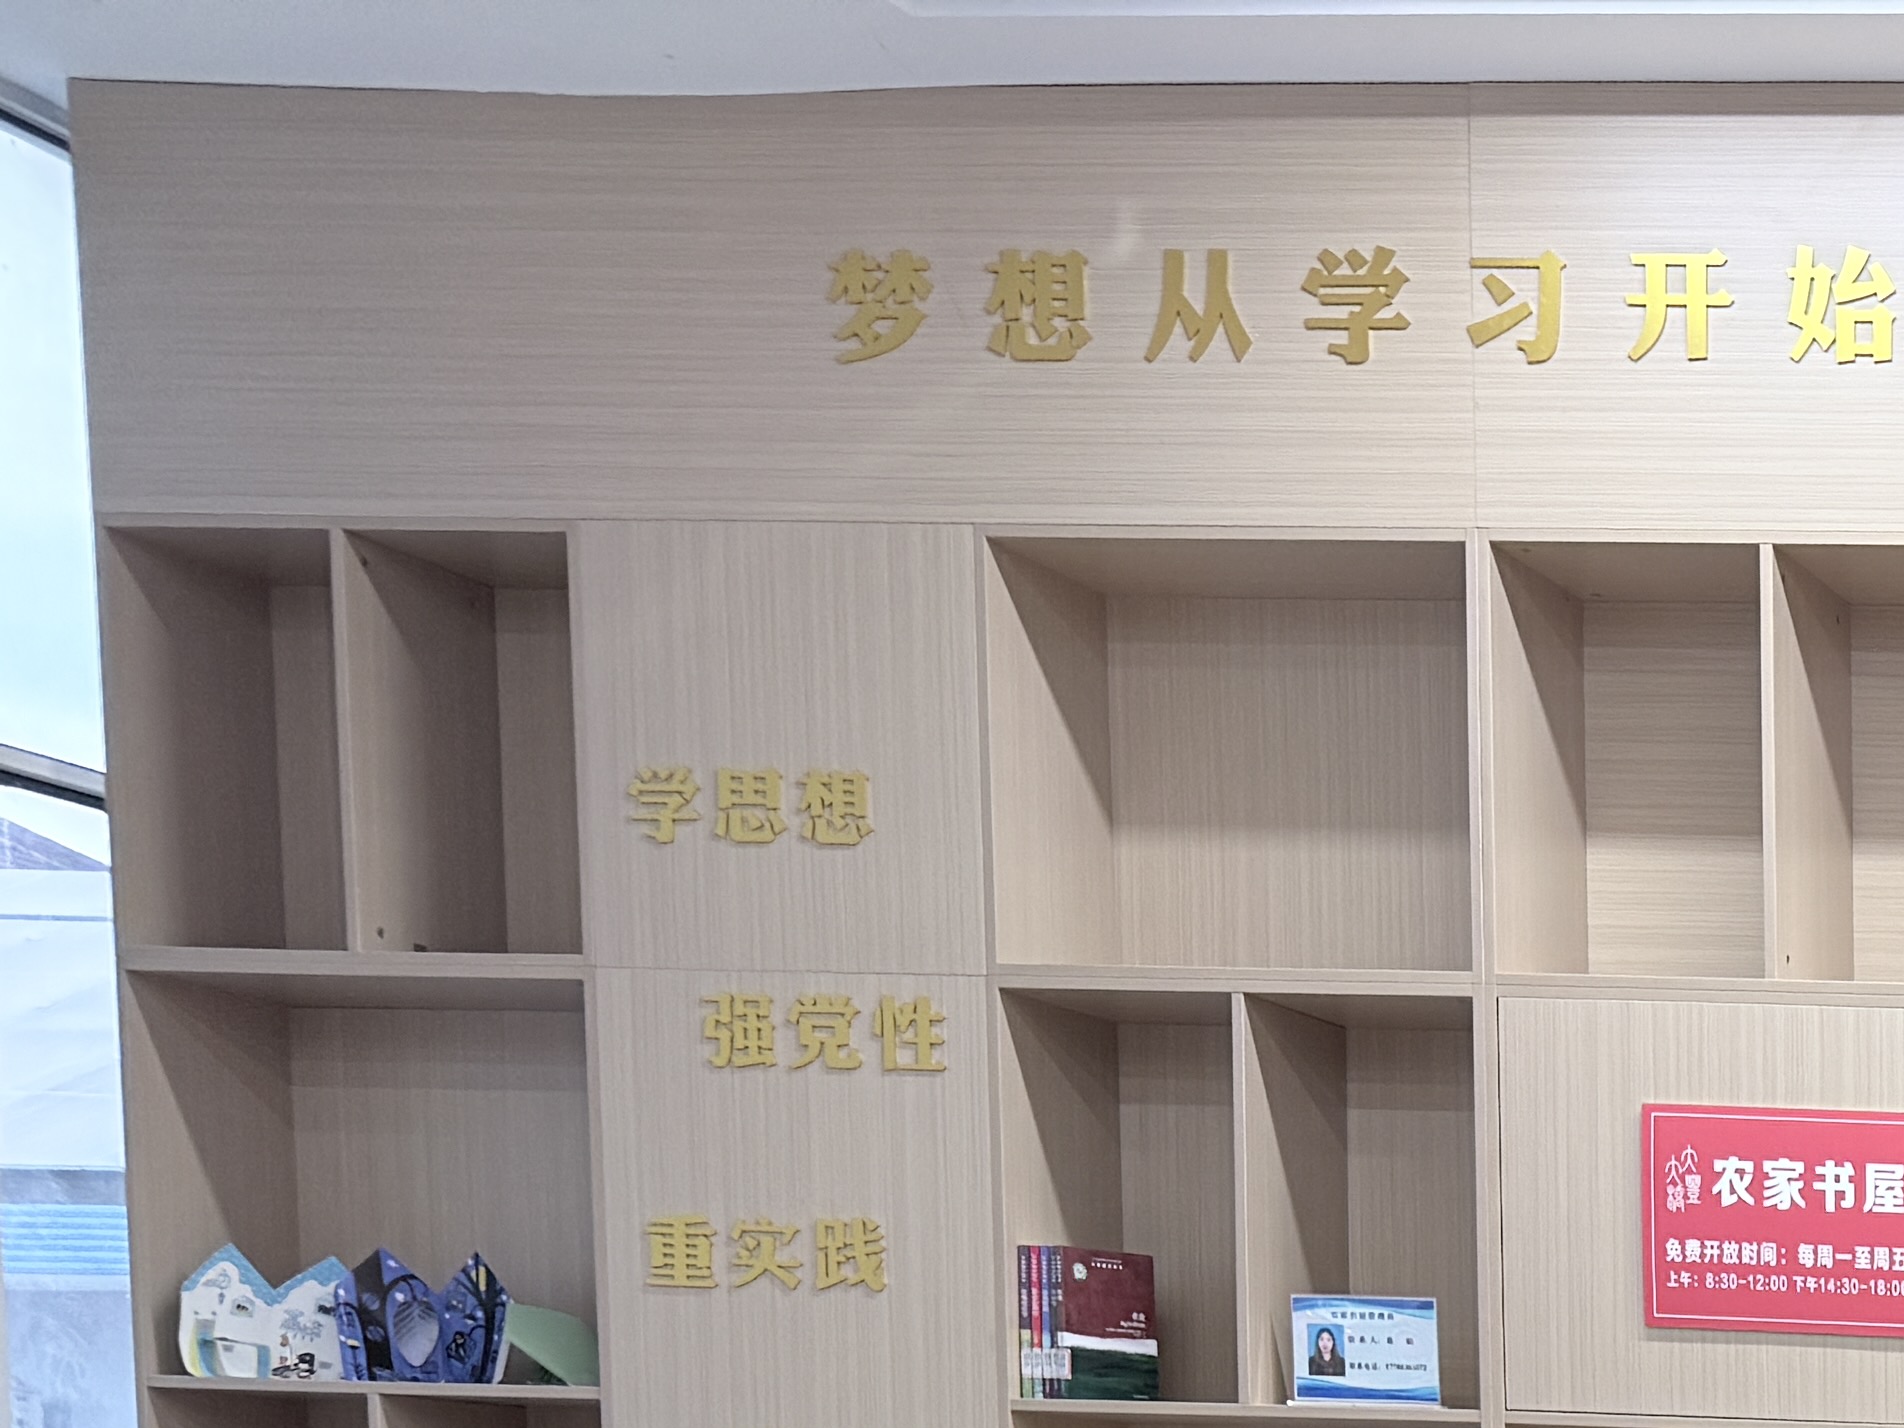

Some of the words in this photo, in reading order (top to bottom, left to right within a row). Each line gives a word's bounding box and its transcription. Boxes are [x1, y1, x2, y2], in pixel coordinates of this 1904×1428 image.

[826, 244, 1898, 365] 梦想从学习开始
[627, 766, 875, 846] 学思想
[700, 992, 948, 1072] 强党性
[645, 1215, 888, 1292] 重实践
